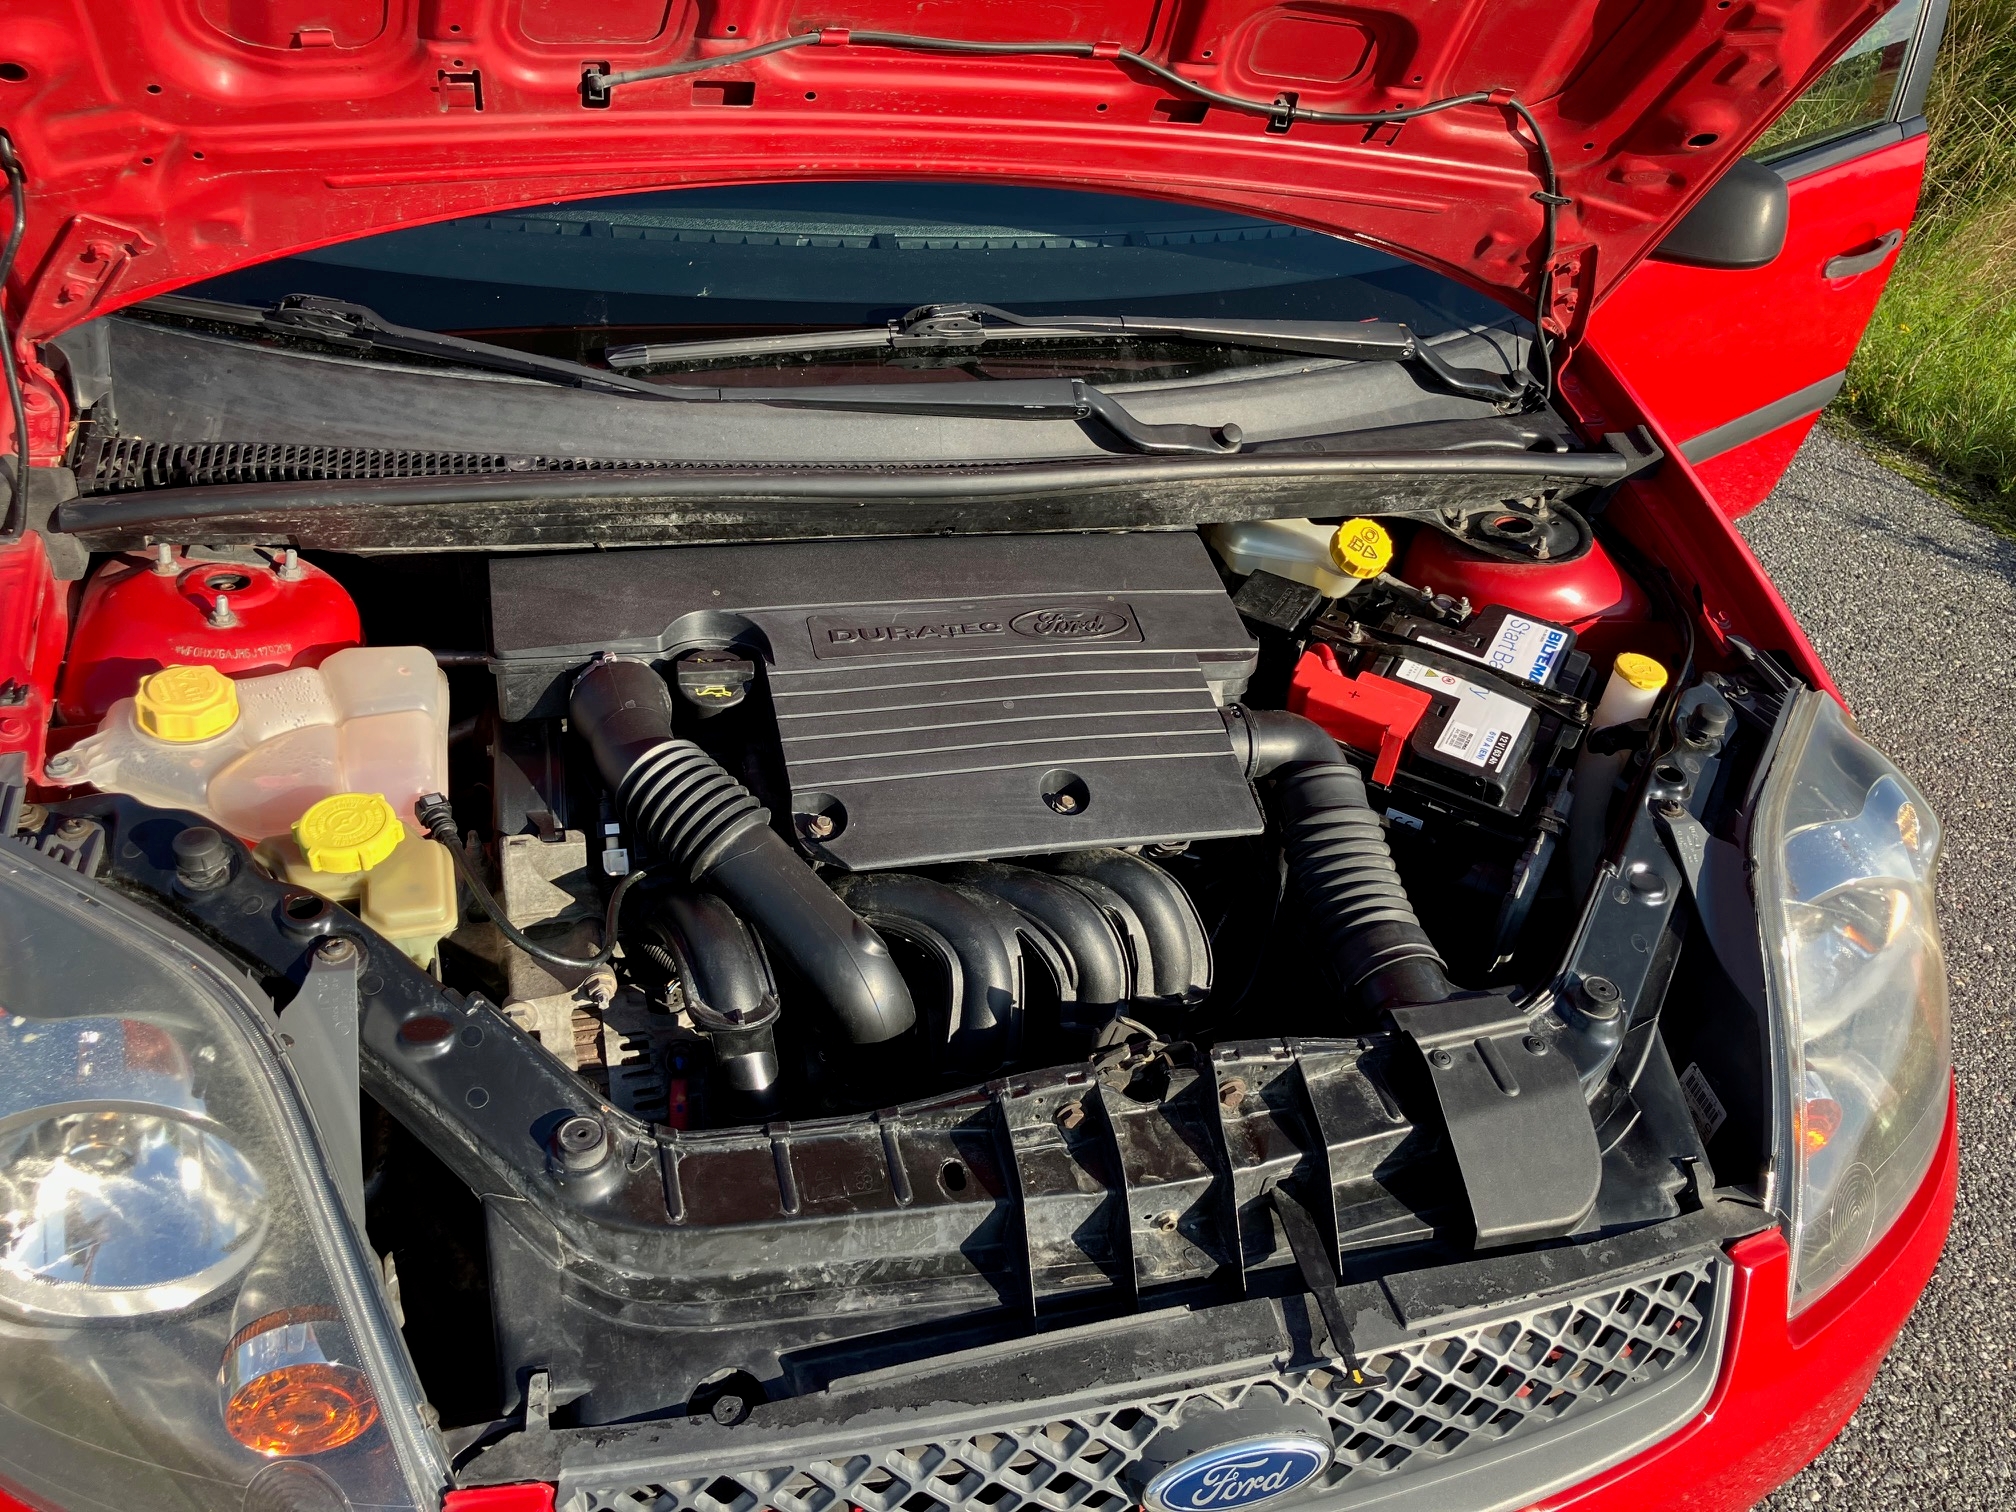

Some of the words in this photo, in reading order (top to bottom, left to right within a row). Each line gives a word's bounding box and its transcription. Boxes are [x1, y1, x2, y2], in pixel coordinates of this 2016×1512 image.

[828, 622, 1005, 644] DURATEC
[1033, 611, 1106, 635] Ford
[1498, 619, 1531, 652] Start
[1191, 1457, 1293, 1506] Ford
